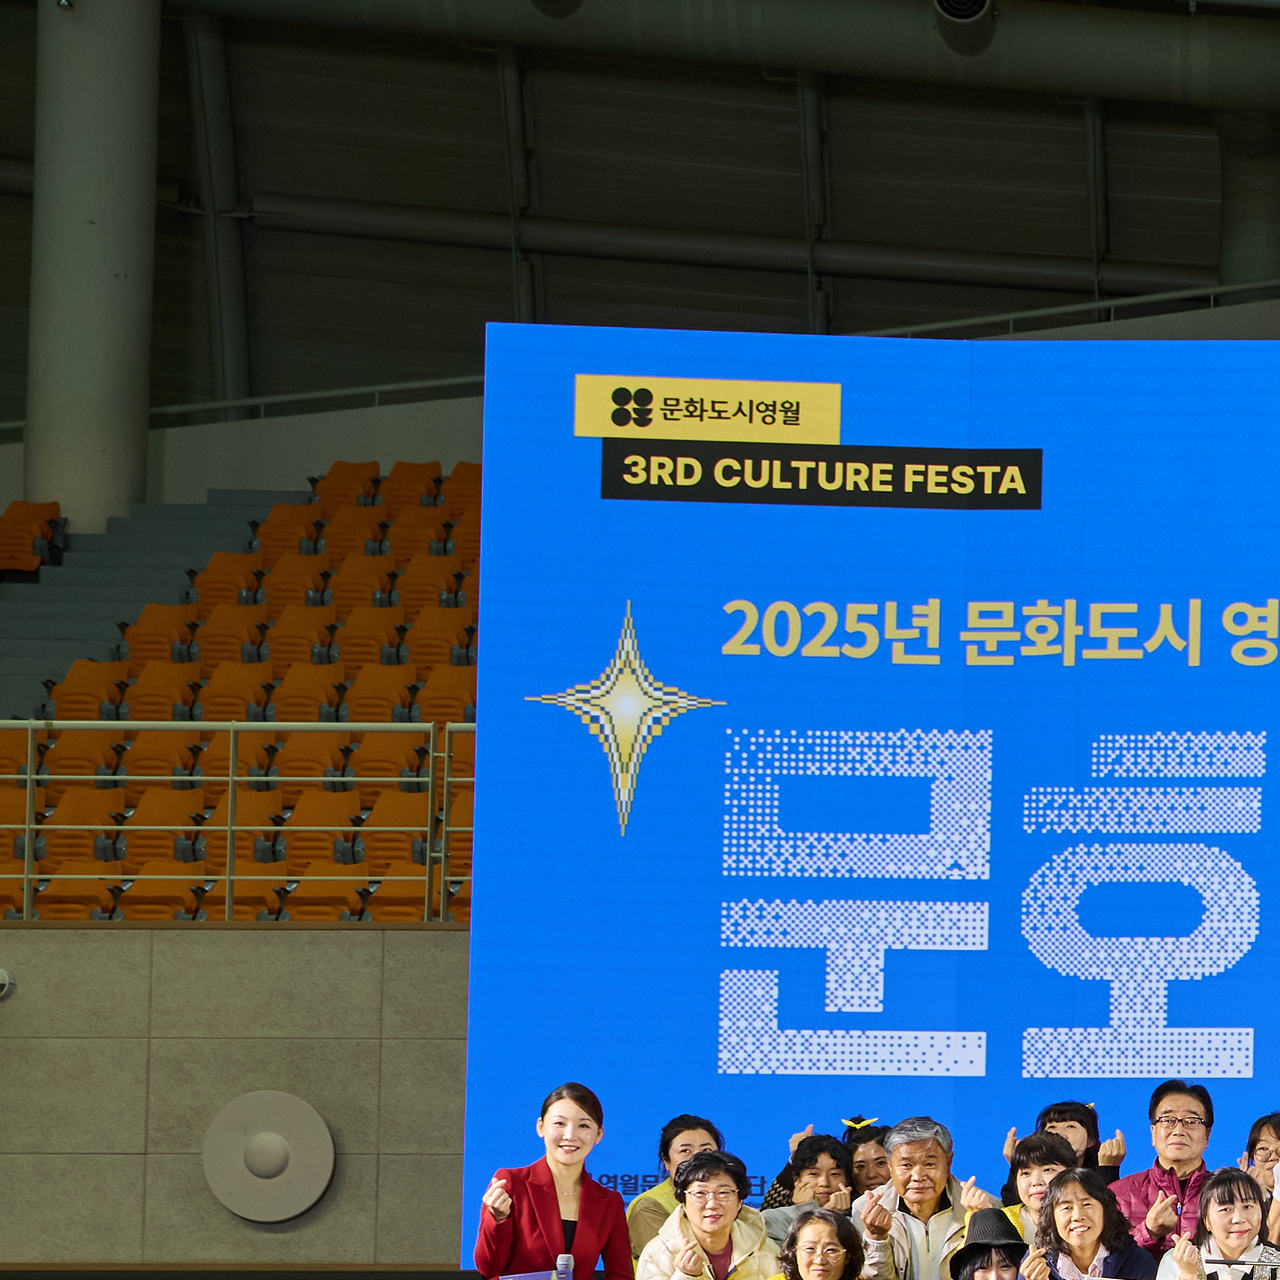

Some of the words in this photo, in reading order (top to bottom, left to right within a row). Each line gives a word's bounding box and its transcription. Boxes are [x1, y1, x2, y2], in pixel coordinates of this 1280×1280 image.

[659, 397, 801, 427] 문화도시영월
[622, 455, 703, 487] 3RD
[713, 458, 894, 493] CULTURE
[904, 464, 1027, 495] FESTA
[721, 598, 942, 667] 2025년
[959, 597, 1203, 667] 문화도시
